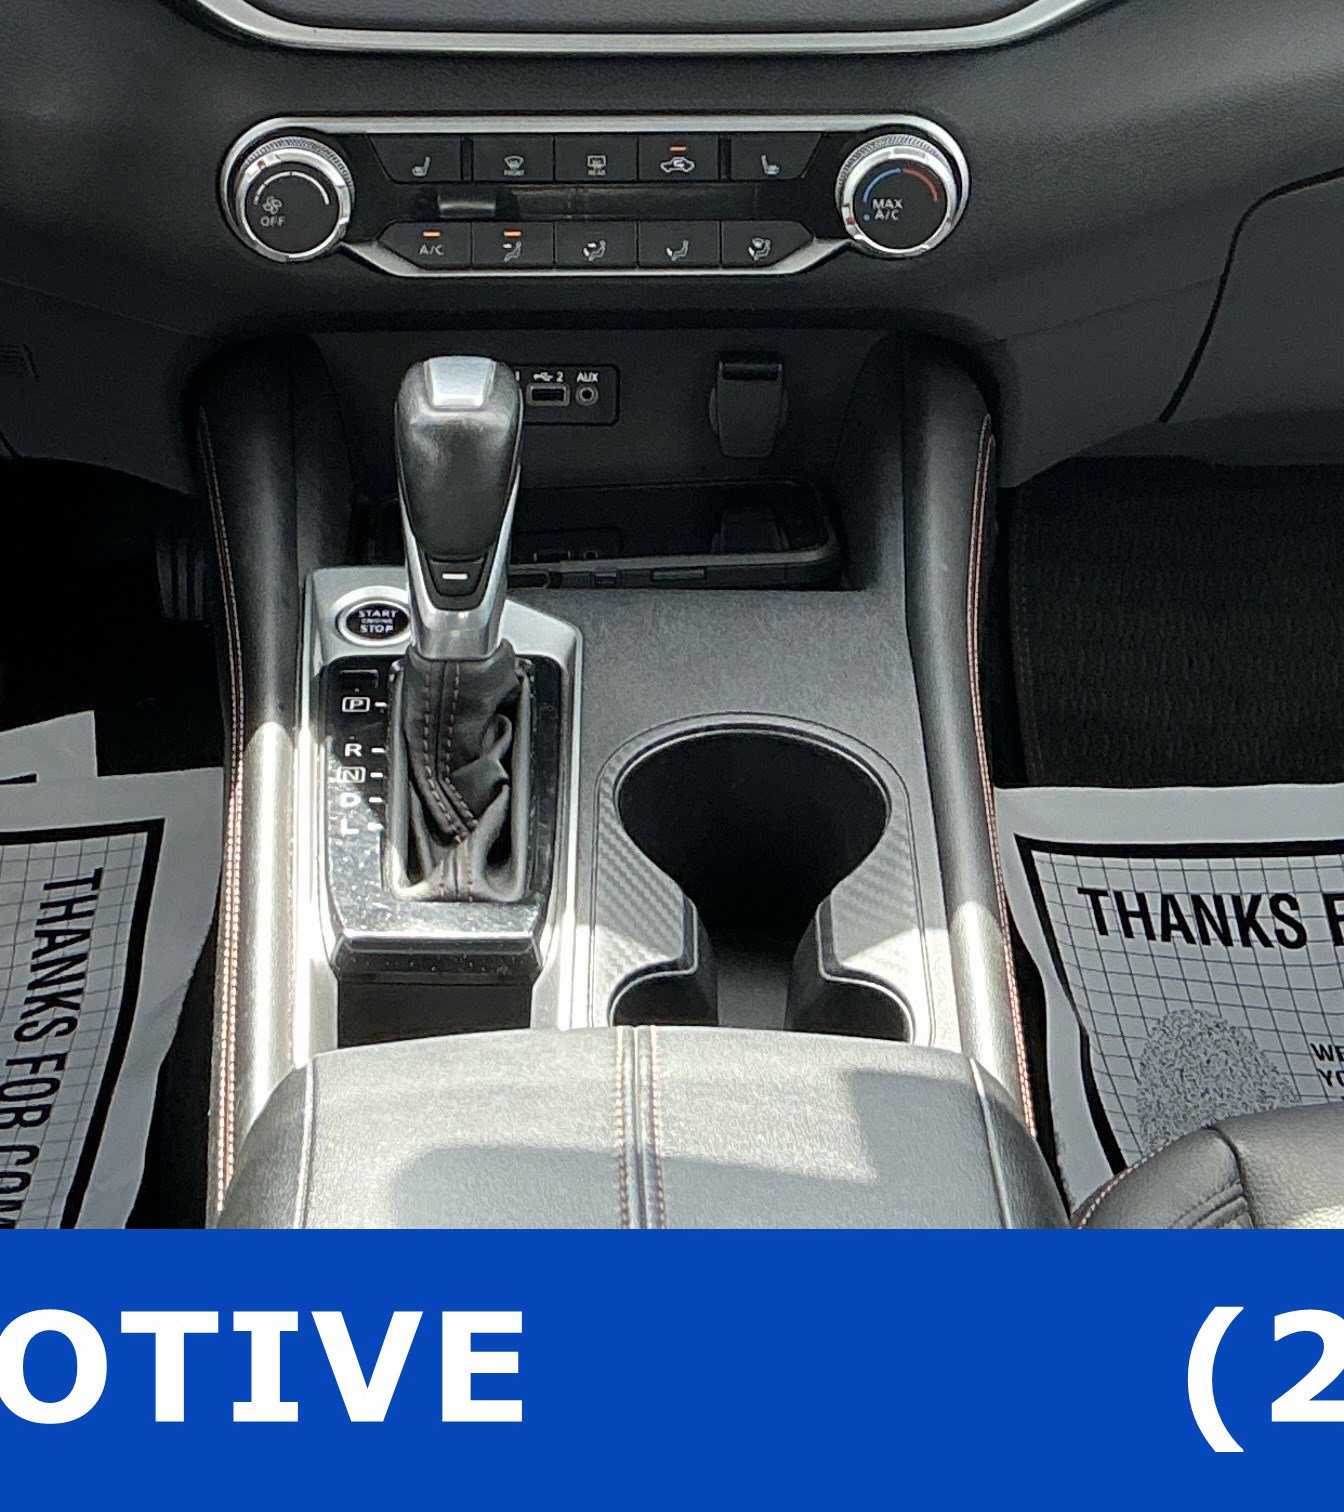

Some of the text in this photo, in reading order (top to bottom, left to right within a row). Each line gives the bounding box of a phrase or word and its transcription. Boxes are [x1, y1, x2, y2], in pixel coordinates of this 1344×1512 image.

[872, 198, 903, 209] MAX
[874, 209, 900, 221] A/C
[260, 216, 285, 227] OFF
[419, 244, 444, 256] A/C
[556, 371, 564, 382] 2
[577, 371, 599, 382] AUX
[359, 609, 397, 618] START
[360, 624, 394, 633] STOP
[344, 743, 363, 757] R
[340, 792, 361, 808] D
[340, 818, 360, 835] L
[1077, 887, 1308, 950] THANKS
[14, 867, 104, 1044] THANKS
